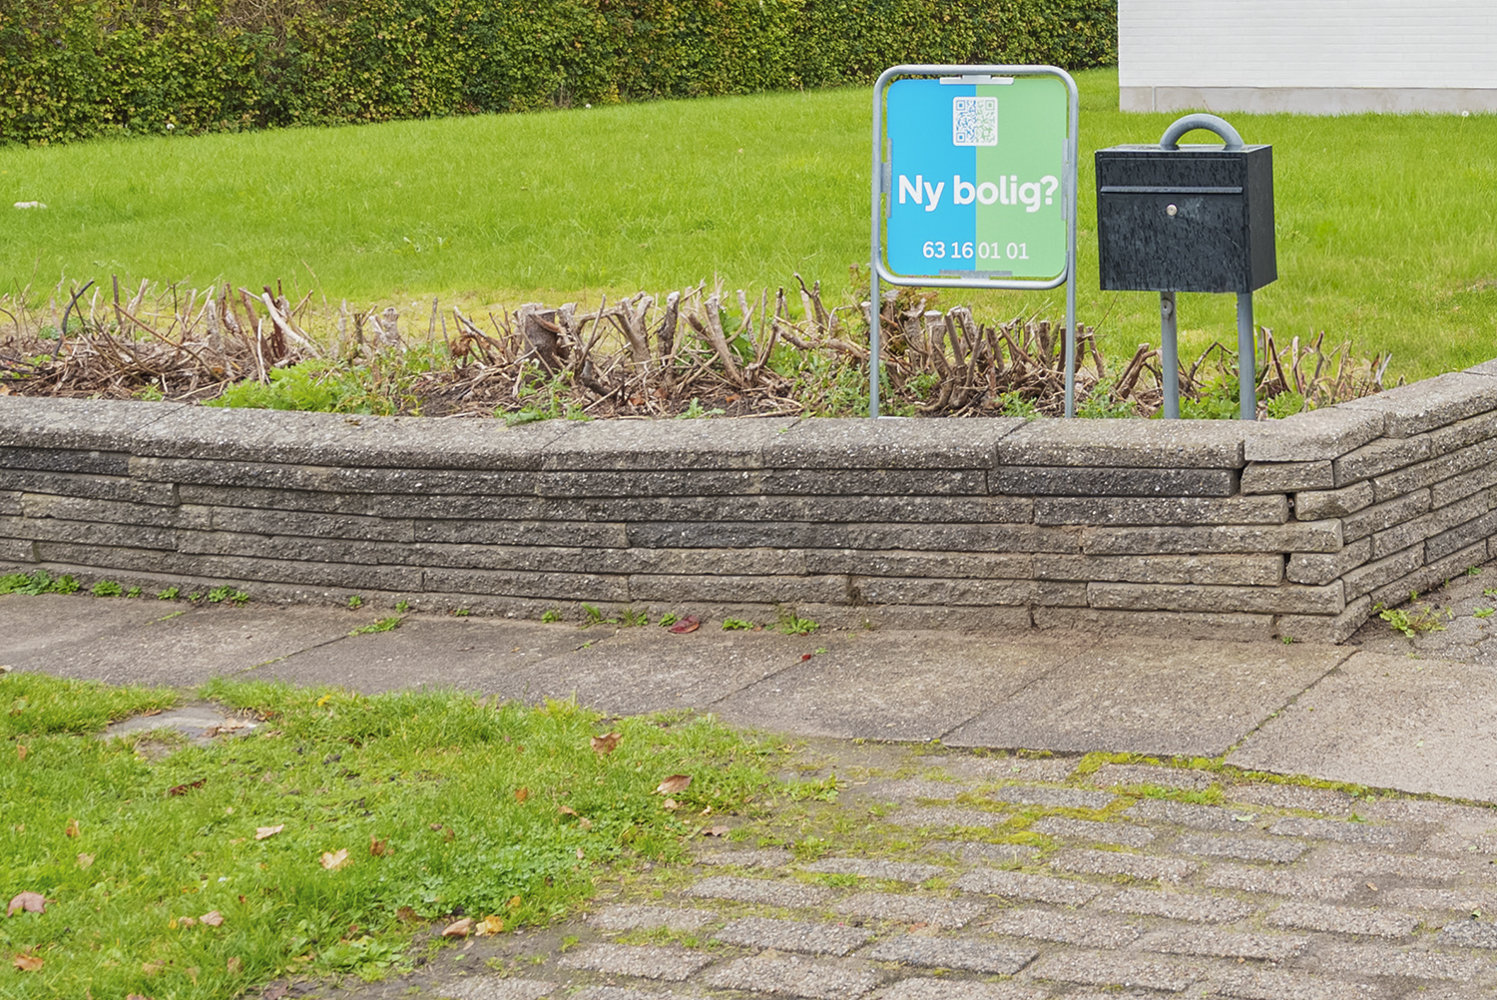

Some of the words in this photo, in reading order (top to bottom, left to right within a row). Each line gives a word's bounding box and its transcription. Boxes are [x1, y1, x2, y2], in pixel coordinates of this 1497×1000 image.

[898, 174, 945, 212] Ny
[953, 174, 1059, 213] bolig?
[922, 241, 946, 259] 63
[951, 241, 974, 259] 16
[978, 241, 1001, 259] 01
[1006, 242, 1029, 260] 01
